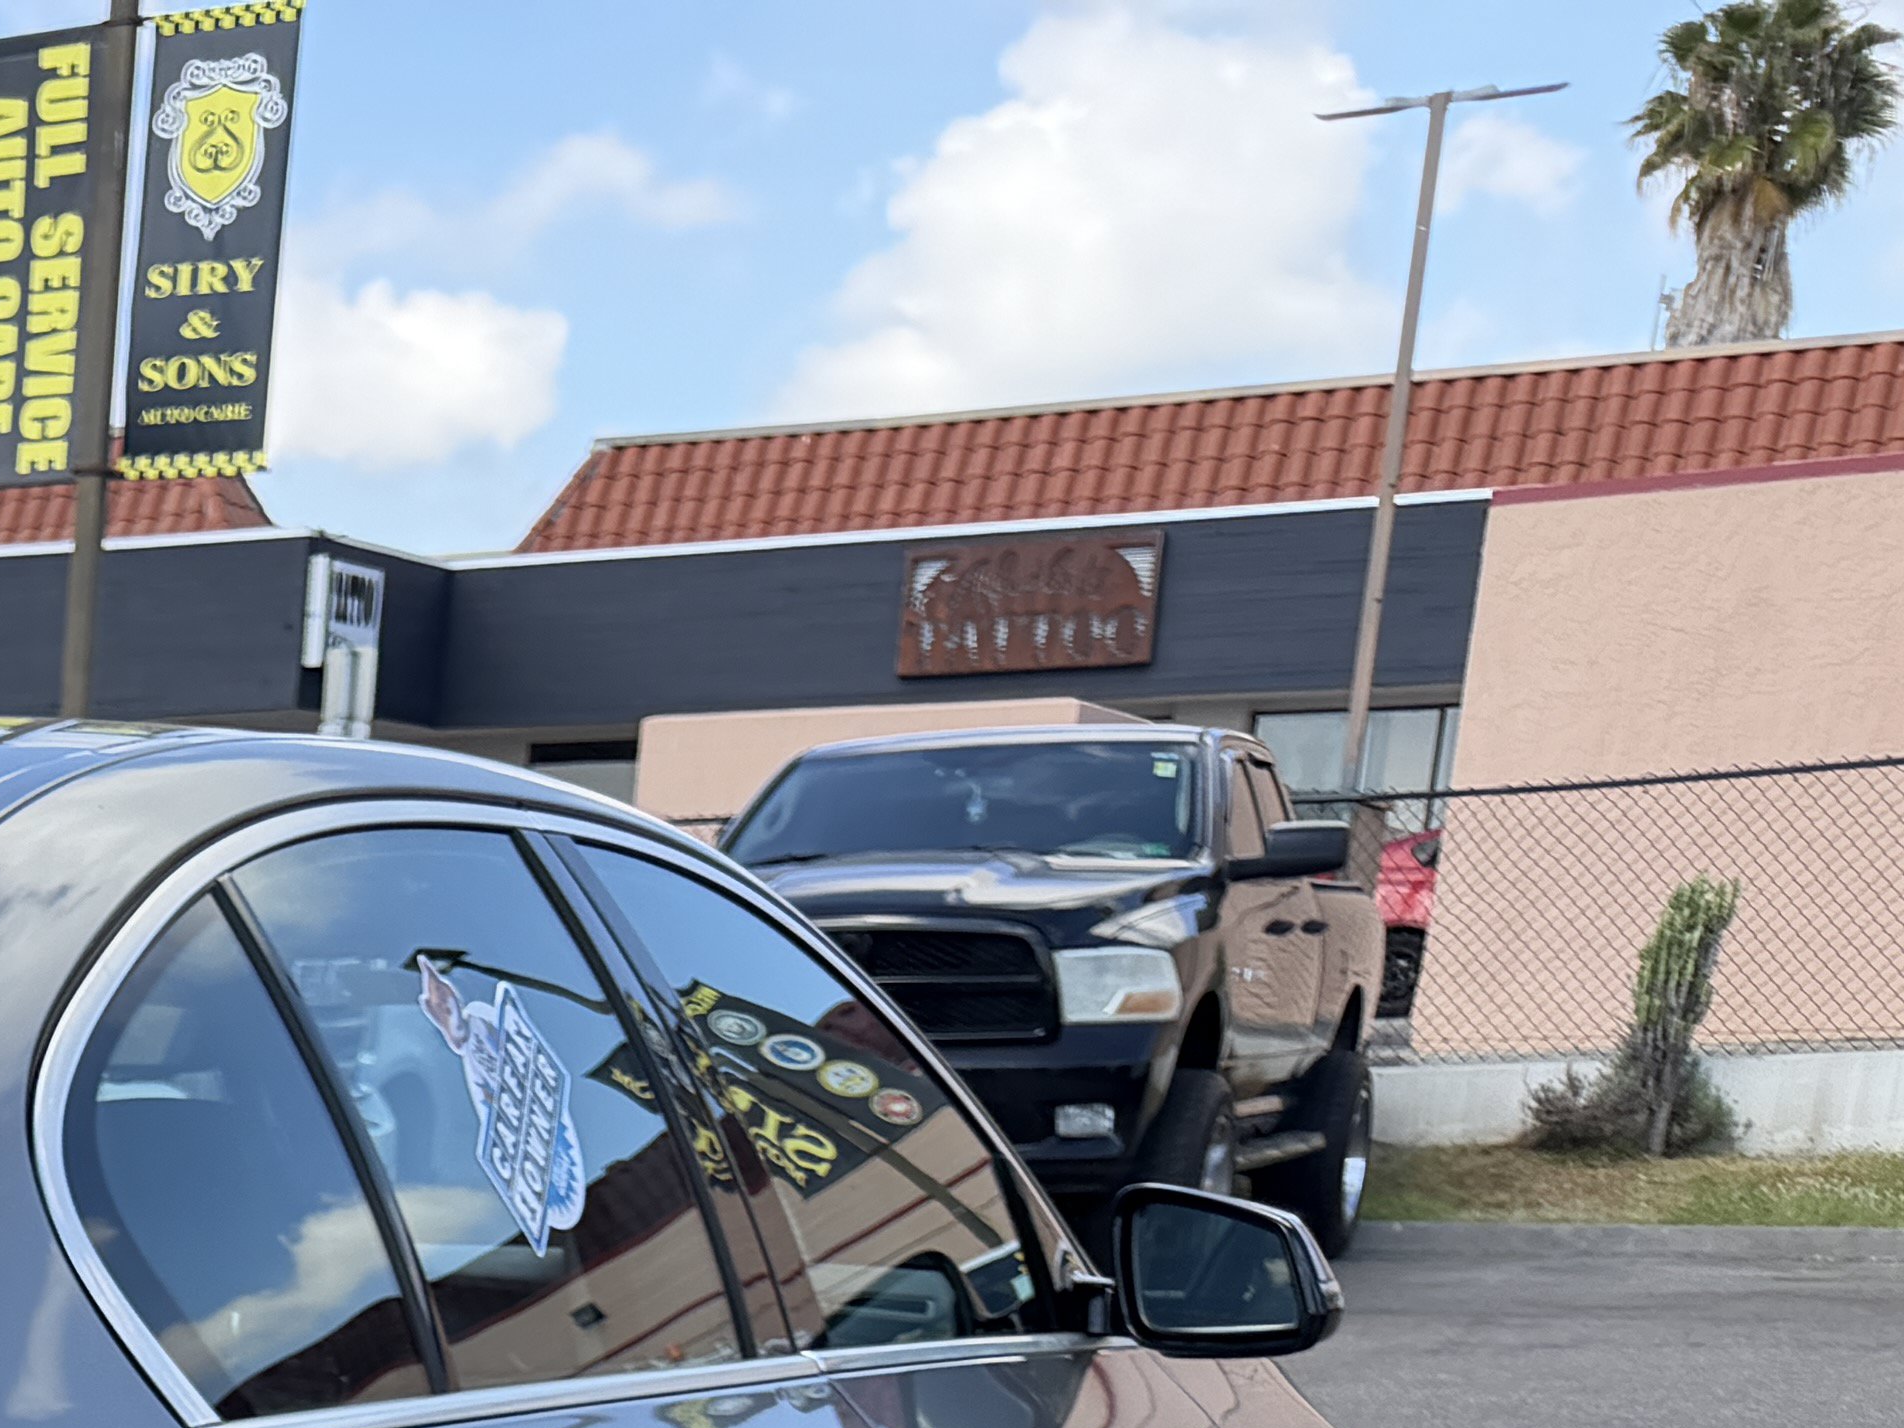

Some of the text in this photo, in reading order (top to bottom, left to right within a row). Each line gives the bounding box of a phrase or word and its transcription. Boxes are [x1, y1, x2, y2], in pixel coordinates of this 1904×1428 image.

[15, 42, 91, 475] FULL SERVICE
[144, 257, 264, 299] SIRY
[179, 309, 221, 340] &
[138, 351, 258, 392] SONS
[522, 1053, 558, 1195] OWNER
